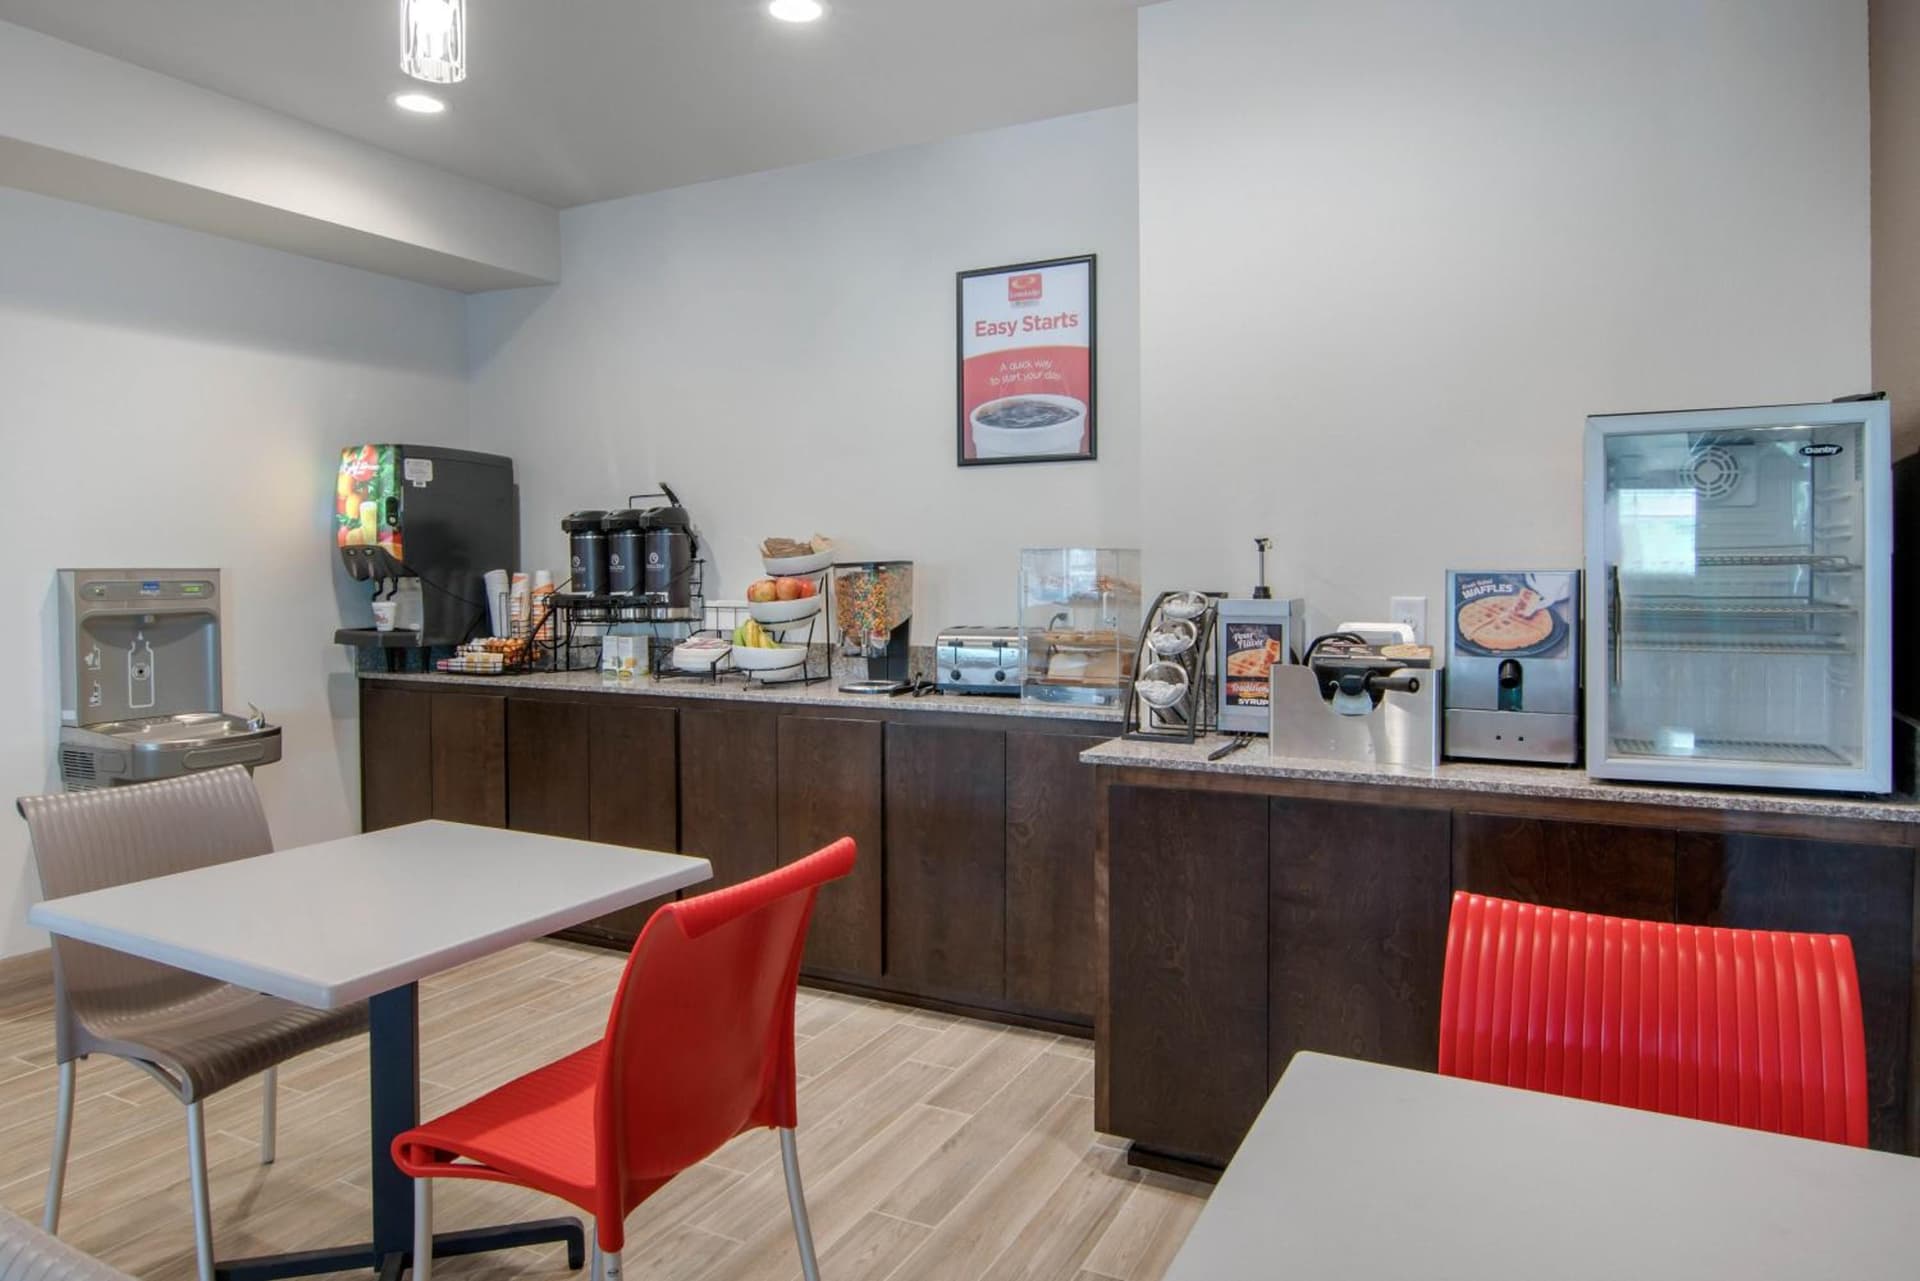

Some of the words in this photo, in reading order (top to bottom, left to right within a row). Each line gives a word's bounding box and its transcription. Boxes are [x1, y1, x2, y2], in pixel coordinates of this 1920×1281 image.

[975, 320, 1017, 337] Easy
[1022, 312, 1078, 332] Starts
[1804, 446, 1839, 454] Danby
[1461, 583, 1513, 599] WAFFLES
